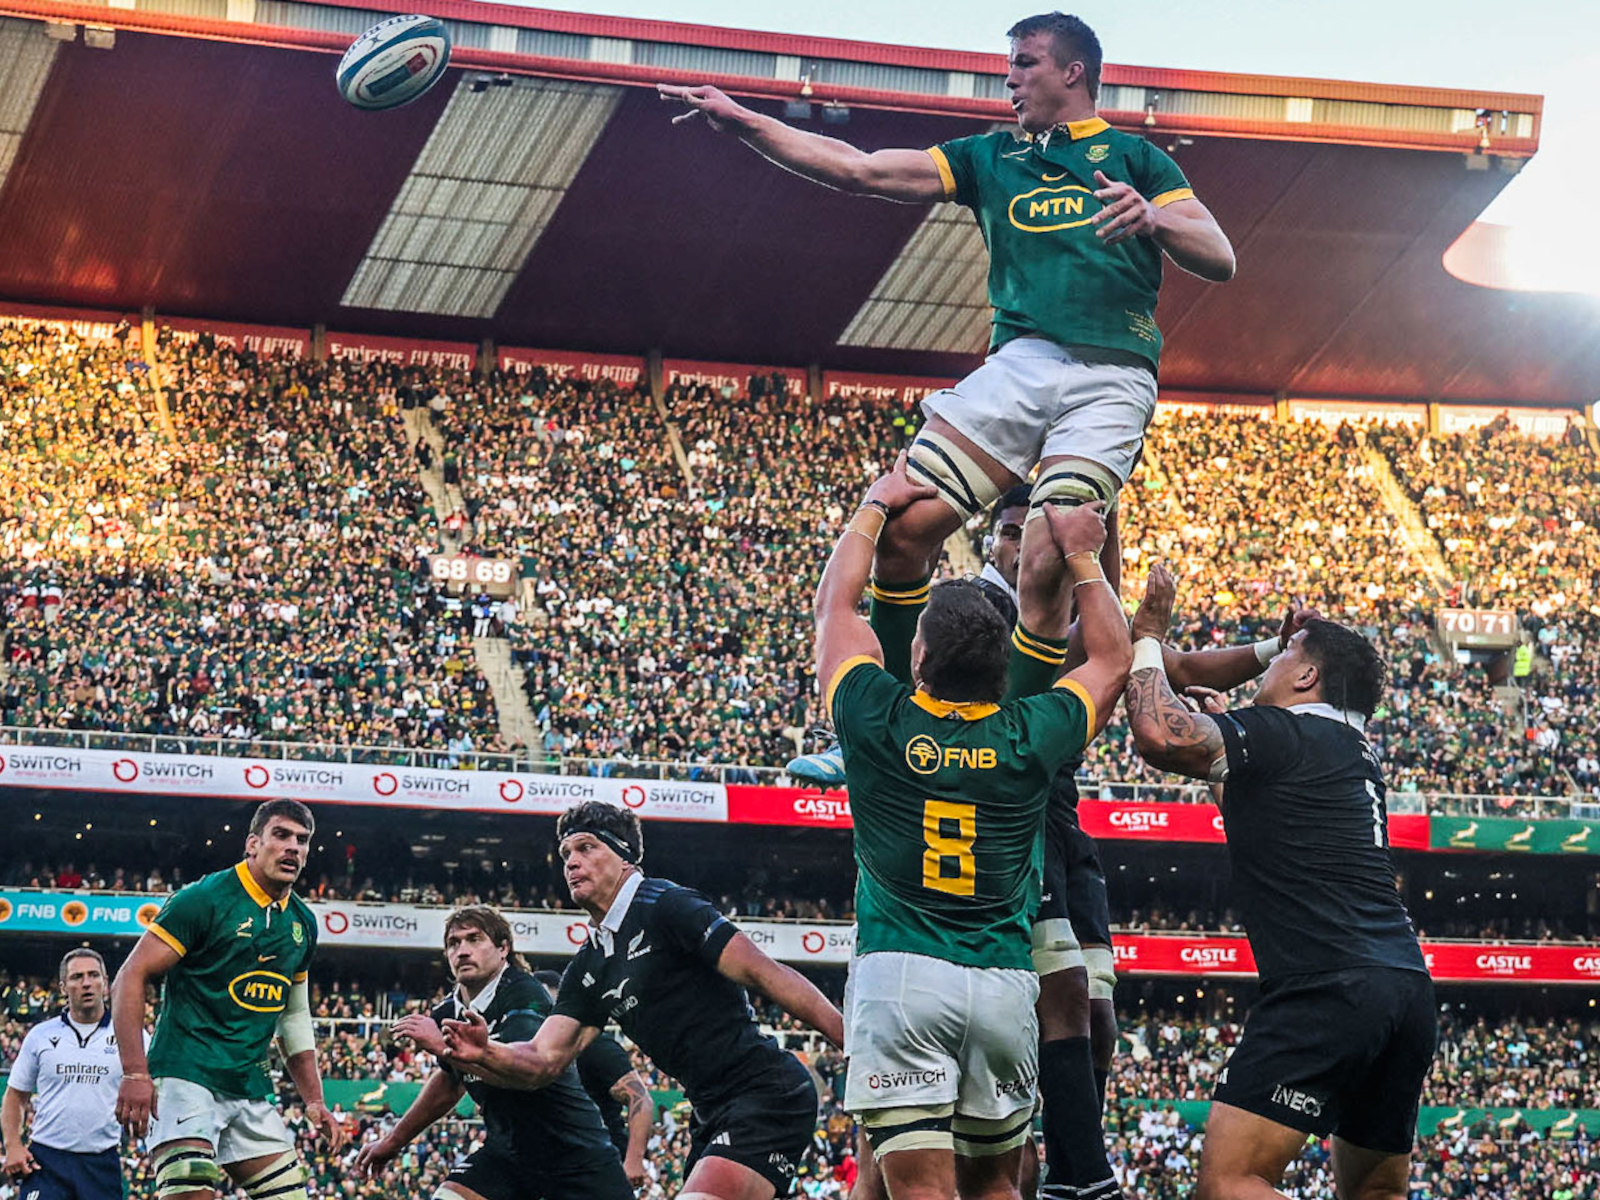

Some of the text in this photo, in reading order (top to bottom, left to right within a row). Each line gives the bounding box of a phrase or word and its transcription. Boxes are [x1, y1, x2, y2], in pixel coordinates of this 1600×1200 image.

[1029, 197, 1084, 218] MTN
[330, 342, 404, 364] Emirates
[432, 558, 511, 583] 68 69
[1443, 612, 1511, 634] 70 71
[943, 747, 998, 769] FNB
[1109, 811, 1169, 826] CASTLE
[1365, 779, 1383, 849] 1
[923, 799, 977, 896] 8
[17, 904, 56, 919] FNB
[92, 907, 131, 922] FNB
[1113, 946, 1138, 959] TLE
[1180, 948, 1237, 962] CASTLE
[1476, 955, 1532, 969] CASTLE
[243, 981, 283, 1001] MTN
[56, 1062, 110, 1075] Emirates
[881, 1067, 947, 1089] SWITCH
